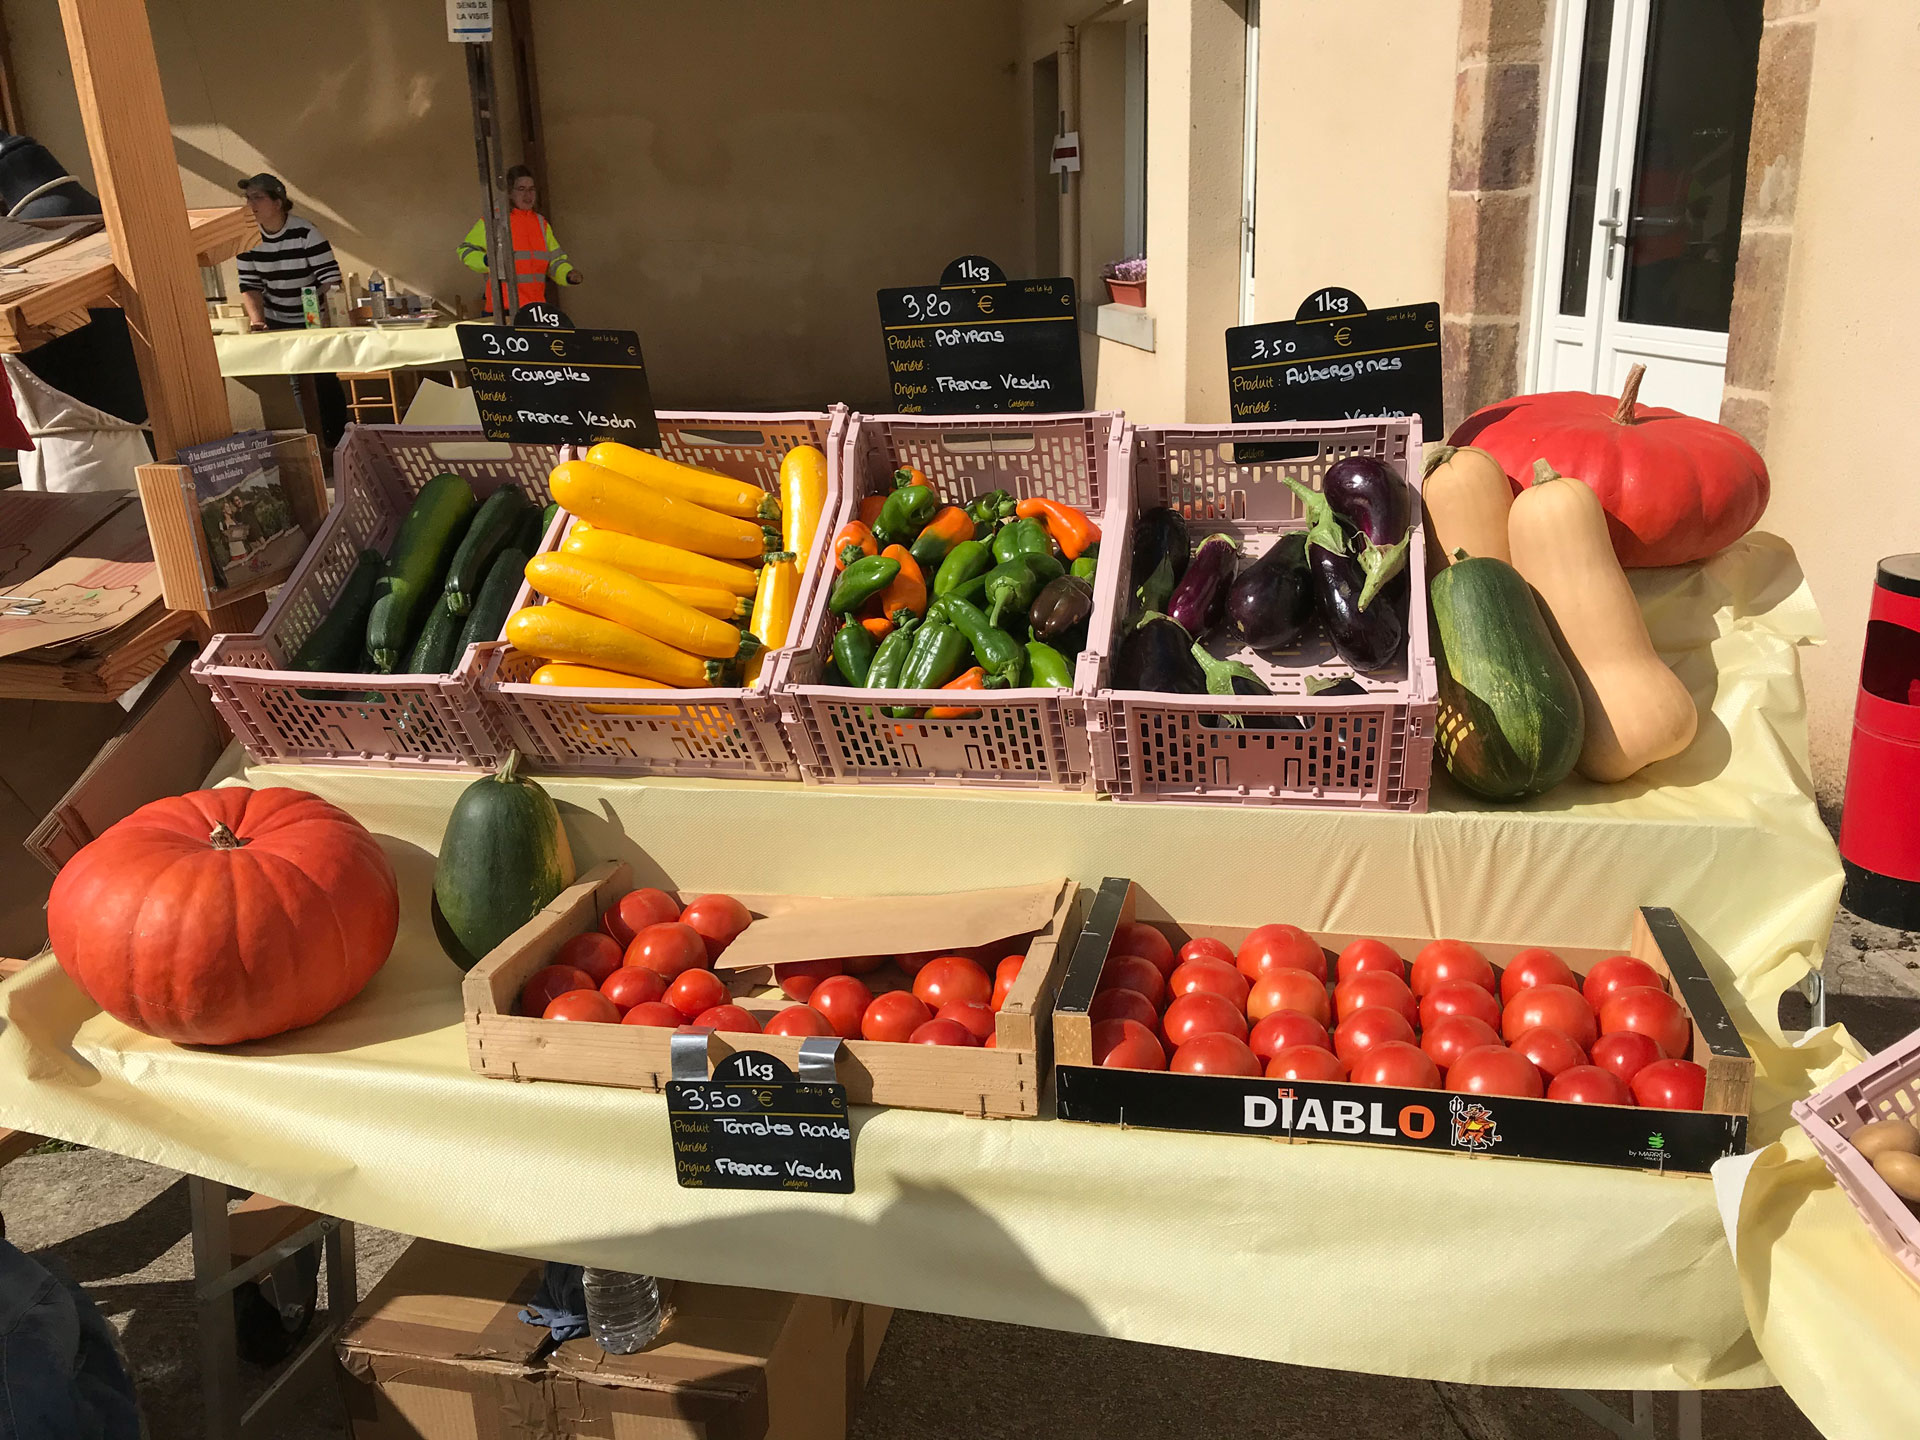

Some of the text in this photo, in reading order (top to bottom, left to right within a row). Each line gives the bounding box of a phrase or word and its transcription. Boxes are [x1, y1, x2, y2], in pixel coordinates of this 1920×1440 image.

[958, 260, 990, 281] 1kg
[903, 294, 994, 321] 3,20 €
[1061, 295, 1070, 305] €
[1314, 292, 1349, 313] 1kg
[529, 306, 560, 327] 1kg
[1425, 320, 1434, 331] €
[482, 334, 566, 356] 3,00 €
[628, 346, 637, 356] €
[1251, 327, 1352, 359] 3,50 €
[578, 410, 636, 429] Vesdun
[734, 1056, 774, 1080] 1kg
[682, 1089, 773, 1110] 3,50 €
[832, 1098, 841, 1108] €
[1277, 1088, 1298, 1100] EL
[713, 1115, 793, 1136] Tomates
[799, 1122, 850, 1139] Rondes
[1244, 1095, 1436, 1139] DIABLO
